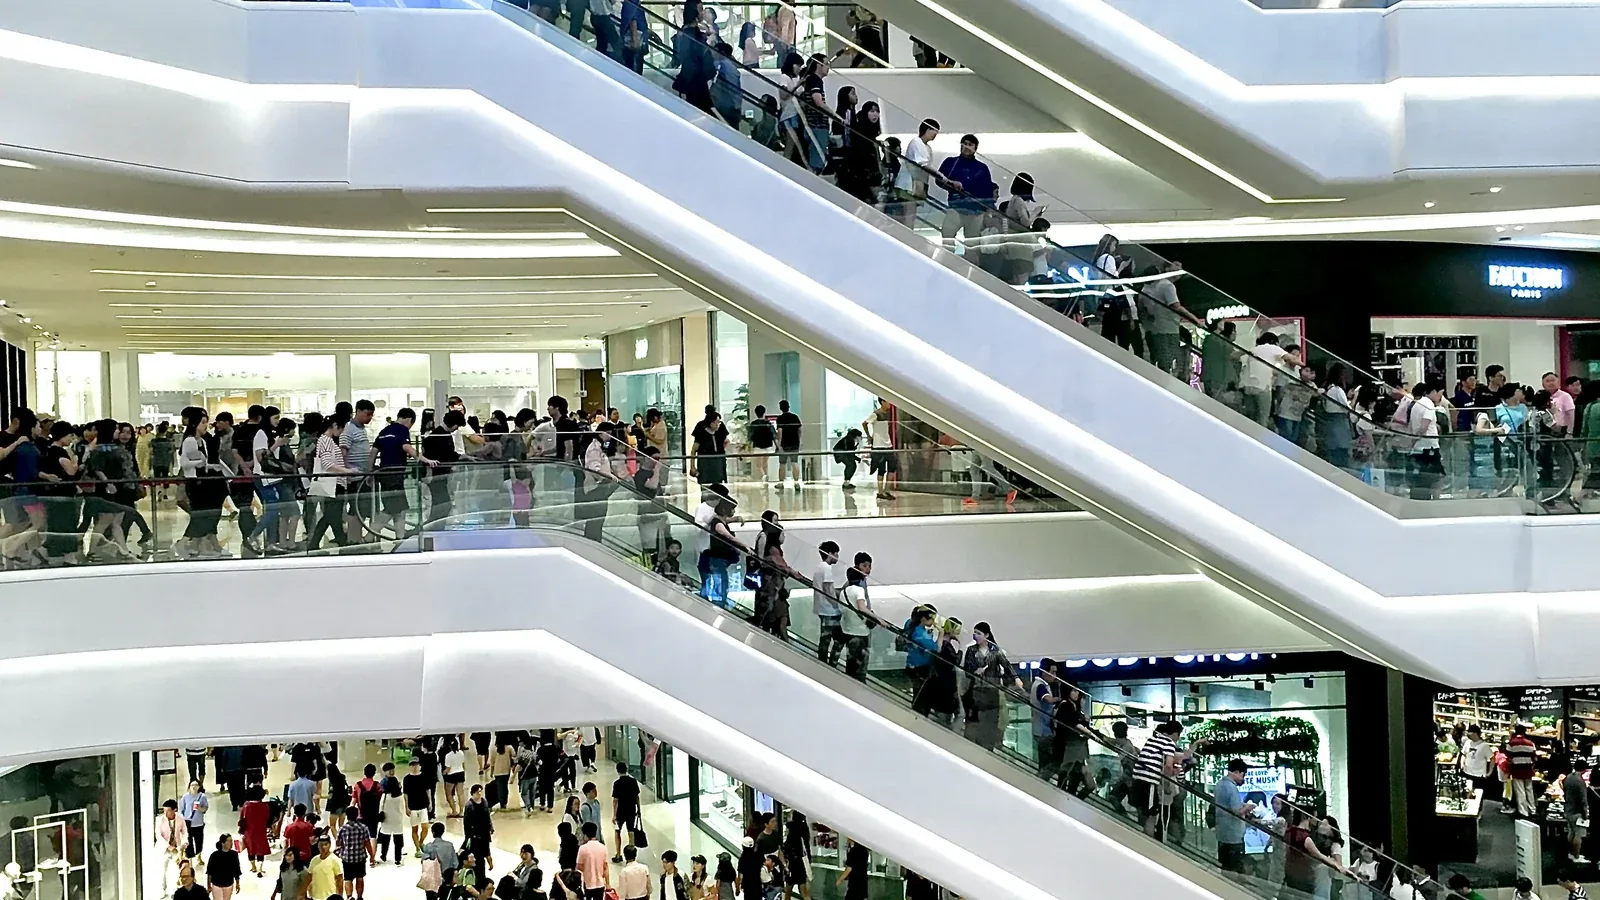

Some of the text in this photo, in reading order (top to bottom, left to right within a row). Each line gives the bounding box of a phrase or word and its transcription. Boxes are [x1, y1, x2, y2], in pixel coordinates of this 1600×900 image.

[1488, 265, 1563, 289] FAUCHON
[1510, 288, 1542, 299] PARIS
[1256, 776, 1276, 784] MUSK
